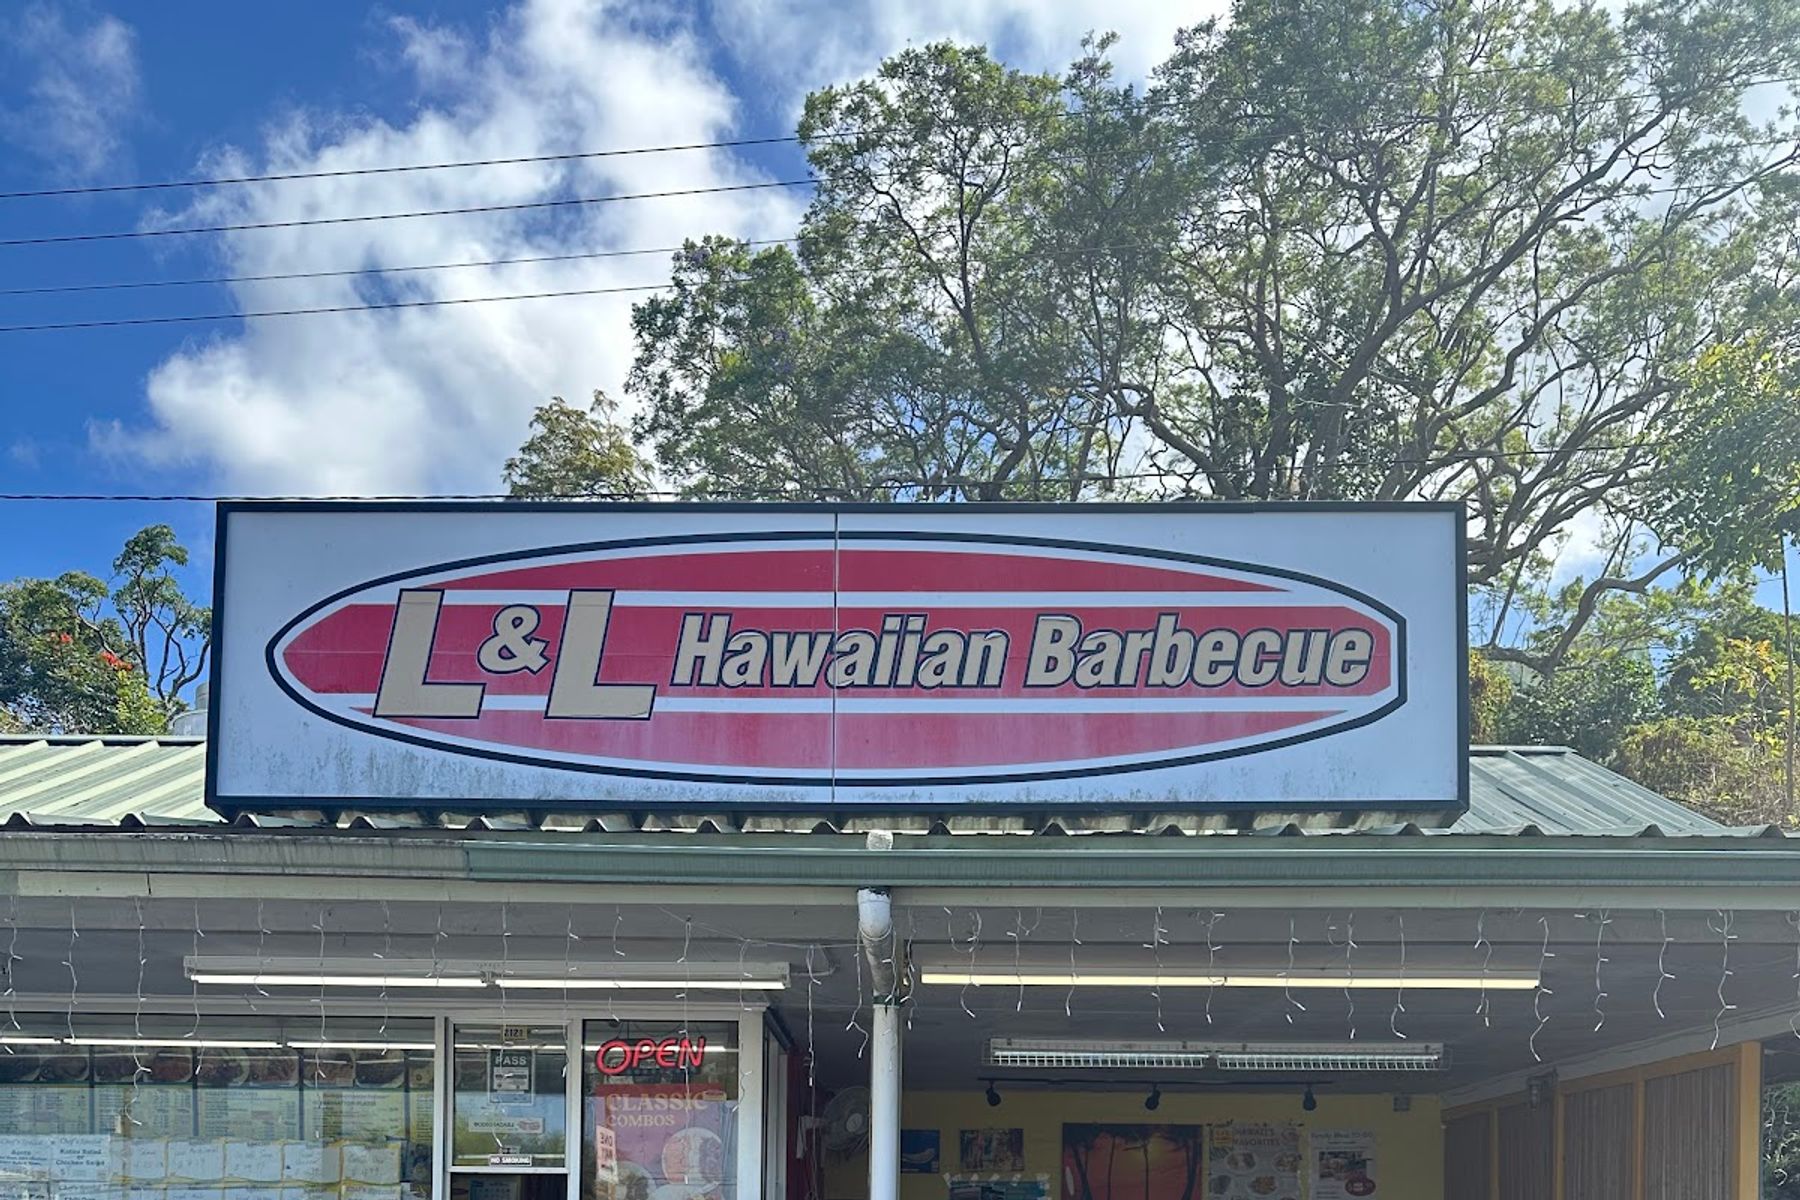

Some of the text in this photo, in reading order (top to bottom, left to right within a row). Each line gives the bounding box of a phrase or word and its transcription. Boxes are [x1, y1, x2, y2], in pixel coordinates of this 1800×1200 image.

[671, 612, 1010, 689] Hawaiian
[1023, 612, 1375, 689] Barbecue
[495, 1055, 528, 1066] PASS
[596, 1036, 706, 1076] OPEN
[606, 1092, 710, 1111] CLASSIC
[607, 1114, 676, 1128] COMBOS
